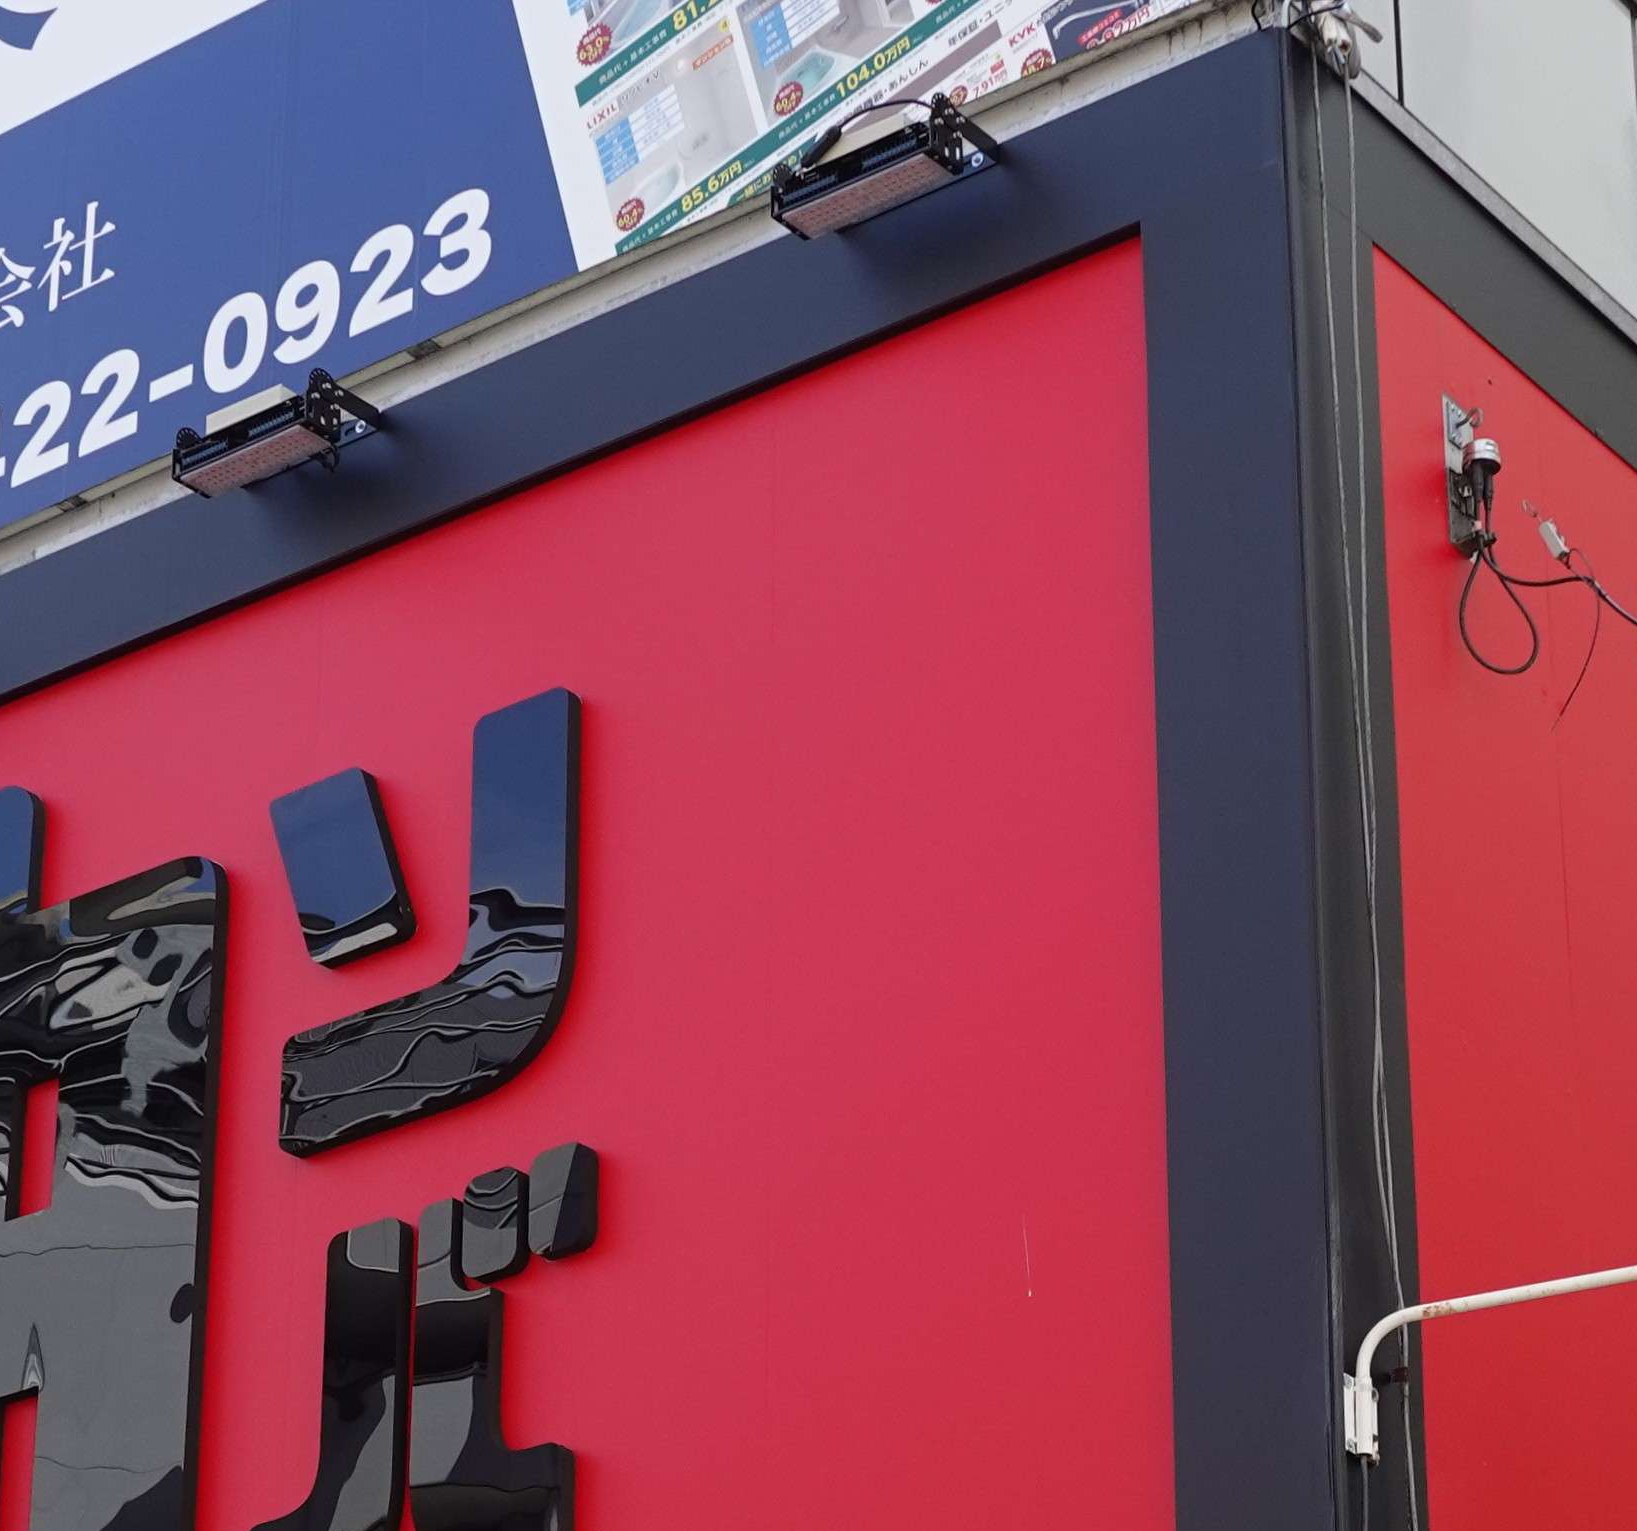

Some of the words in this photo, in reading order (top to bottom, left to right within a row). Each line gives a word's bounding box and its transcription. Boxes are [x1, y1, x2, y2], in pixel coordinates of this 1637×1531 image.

[672, 0, 721, 31] 81.
[1008, 22, 1036, 48] KVK
[836, 36, 910, 98] 104.0万円
[586, 104, 617, 129] LIXIL
[681, 159, 743, 212] 85.6万円
